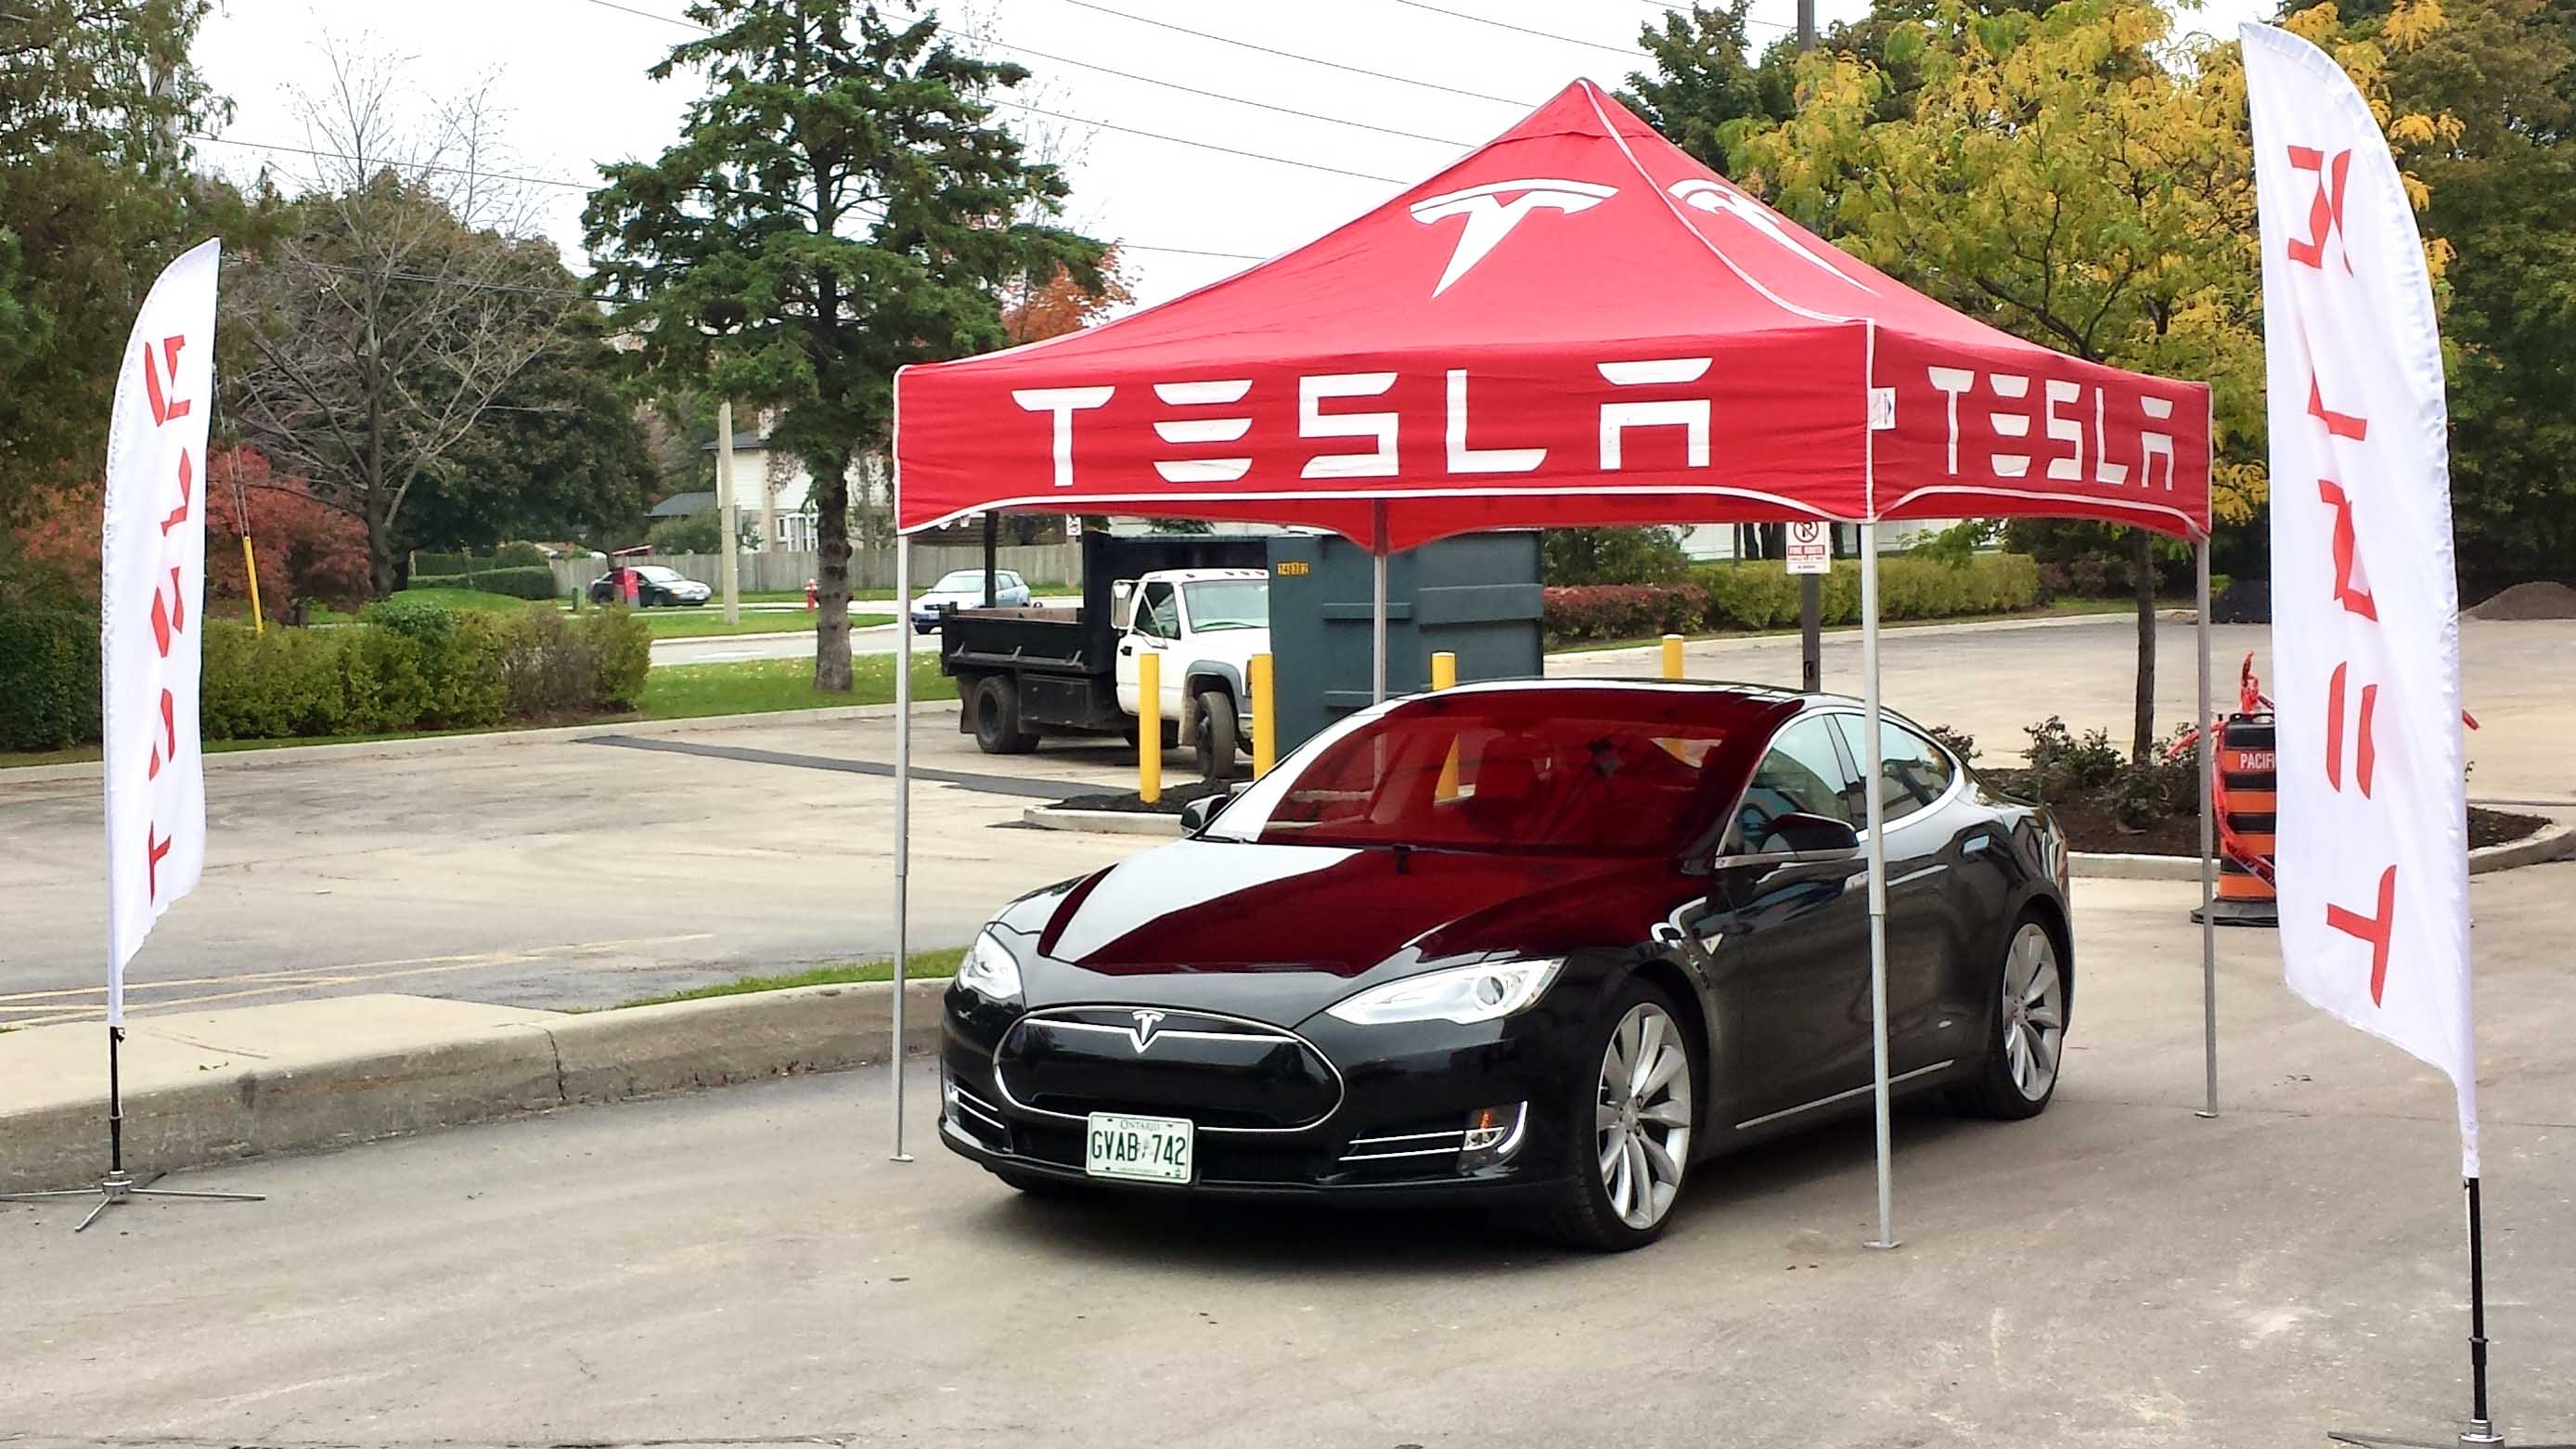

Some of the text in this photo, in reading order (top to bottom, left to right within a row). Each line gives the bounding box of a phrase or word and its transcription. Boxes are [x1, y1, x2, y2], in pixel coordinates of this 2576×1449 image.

[1011, 357, 1714, 488] TESLA
[1927, 365, 2175, 492] TESLA
[2239, 753, 2276, 770] PACIFI
[1092, 1131, 1186, 1167] GVAB 742
